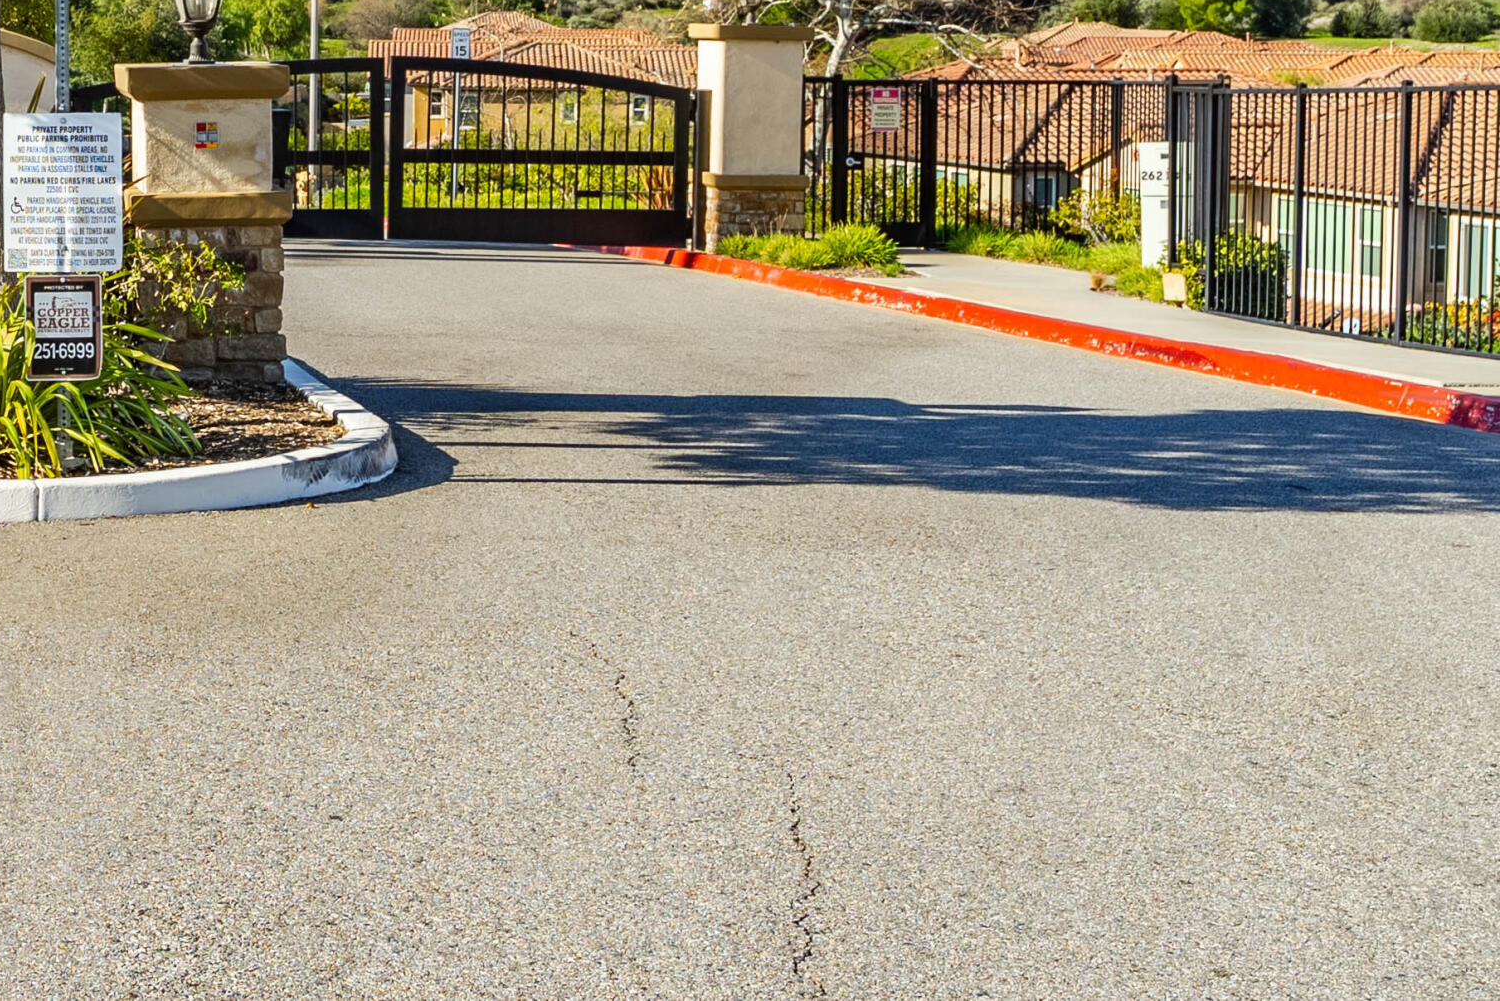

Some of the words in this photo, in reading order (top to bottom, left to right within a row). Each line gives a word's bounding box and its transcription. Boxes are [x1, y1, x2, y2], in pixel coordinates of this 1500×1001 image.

[455, 45, 467, 57] 15
[17, 135, 40, 143] PUBLIC
[42, 135, 69, 143] PARKING
[70, 135, 109, 143] PROHIBITED
[10, 155, 41, 163] INOPERABLE
[42, 155, 49, 163] OR
[50, 155, 89, 163] UNREGISTERED
[18, 165, 40, 173] PARKING
[41, 165, 47, 173] IN
[48, 165, 73, 173] ASSIGNED
[74, 165, 93, 173] STALLS
[94, 165, 107, 173] ONLY
[1141, 171, 1163, 180] 262
[25, 206, 45, 214] DISPLAY
[76, 206, 96, 214] SPECIAL
[96, 206, 117, 214] LICENSE
[37, 308, 89, 317] COPPER
[37, 317, 90, 328] EAGLE
[34, 342, 95, 359] 251-6999
